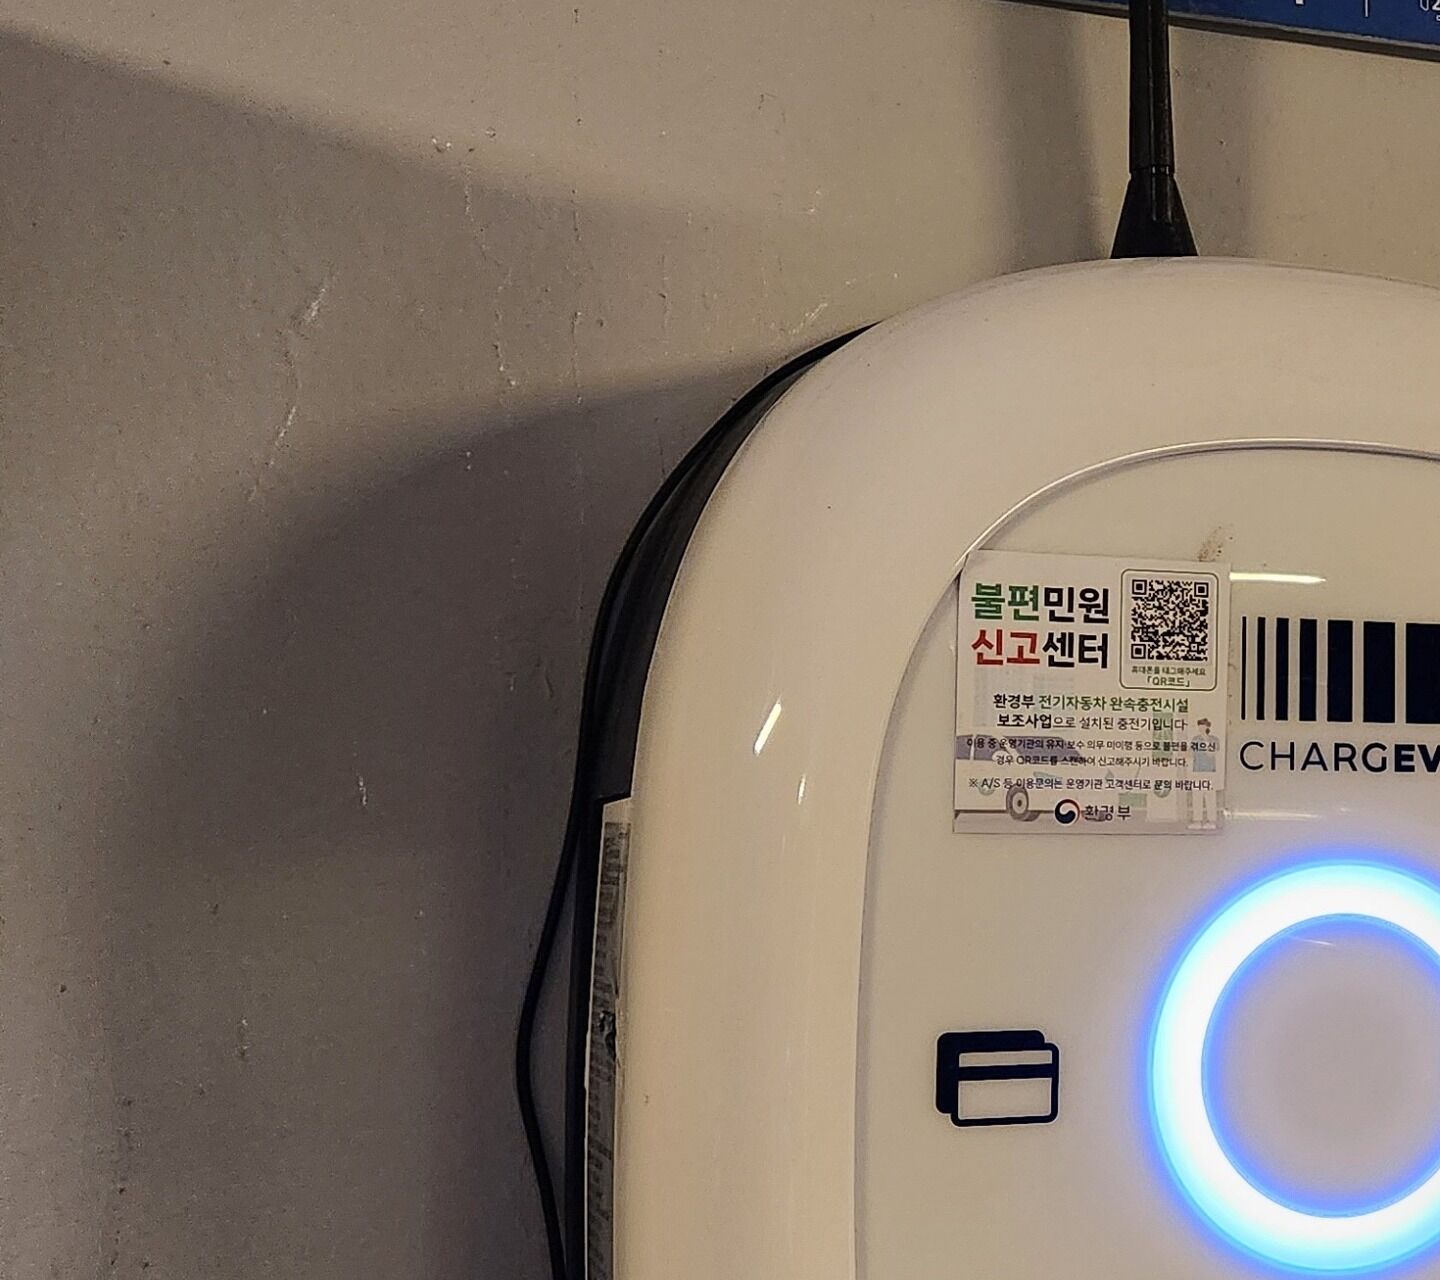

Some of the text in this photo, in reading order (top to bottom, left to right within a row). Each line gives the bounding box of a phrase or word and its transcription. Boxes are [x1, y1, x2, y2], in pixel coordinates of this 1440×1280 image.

[971, 582, 1110, 624] 불편민원
[971, 628, 1109, 669] 신고센터
[993, 694, 1189, 713] 환경부 전기자동차 완속충전시설
[997, 714, 1076, 729] 보조사업으로
[1079, 717, 1114, 730] 설치된
[1084, 805, 1131, 822] 환경부
